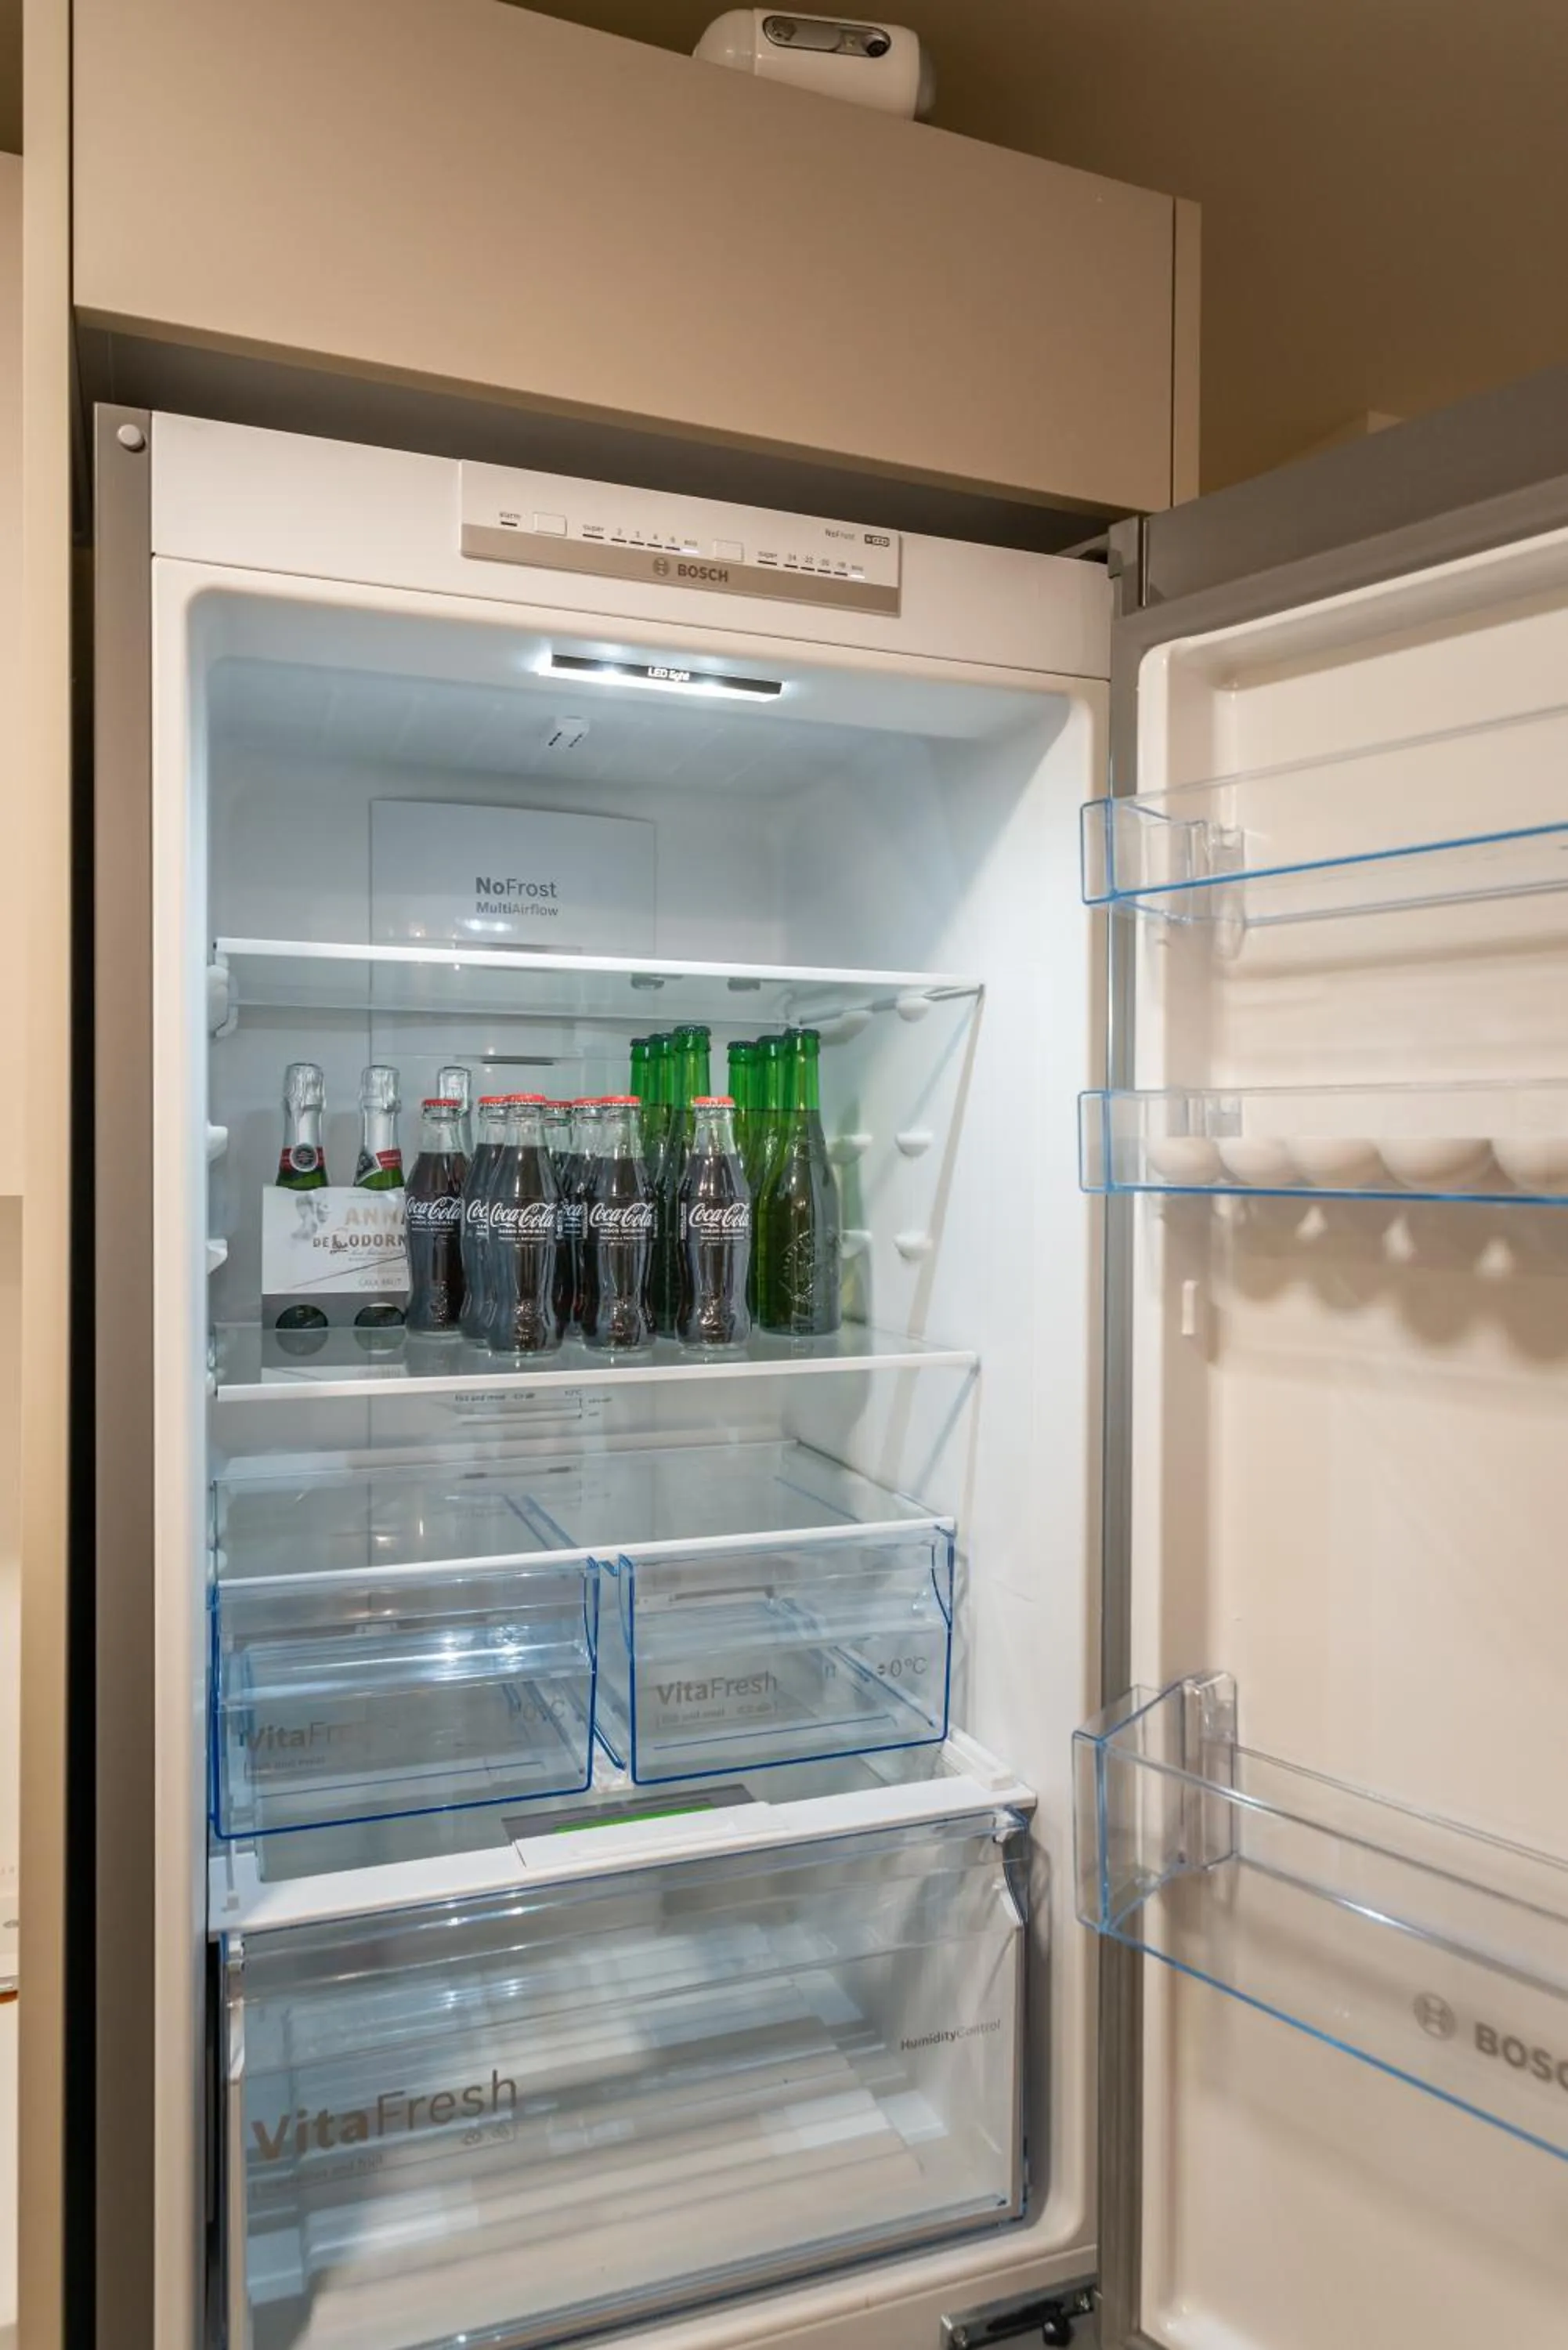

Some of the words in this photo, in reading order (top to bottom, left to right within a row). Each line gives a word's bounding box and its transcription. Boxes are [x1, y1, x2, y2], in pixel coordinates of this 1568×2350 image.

[677, 563, 728, 583] BOSCH
[648, 667, 667, 678] LED
[669, 669, 690, 682] light
[475, 877, 558, 898] NoFrost
[475, 902, 558, 916] MultiAirflow
[490, 1202, 558, 1228] Coca-Cola
[589, 1202, 656, 1227] Coca-Cola
[688, 1202, 750, 1227] Coca-Cola
[656, 1671, 777, 1706] VitaFresh
[901, 2019, 1001, 2052] HumidityControl
[251, 2069, 518, 2160] VitaFresh
